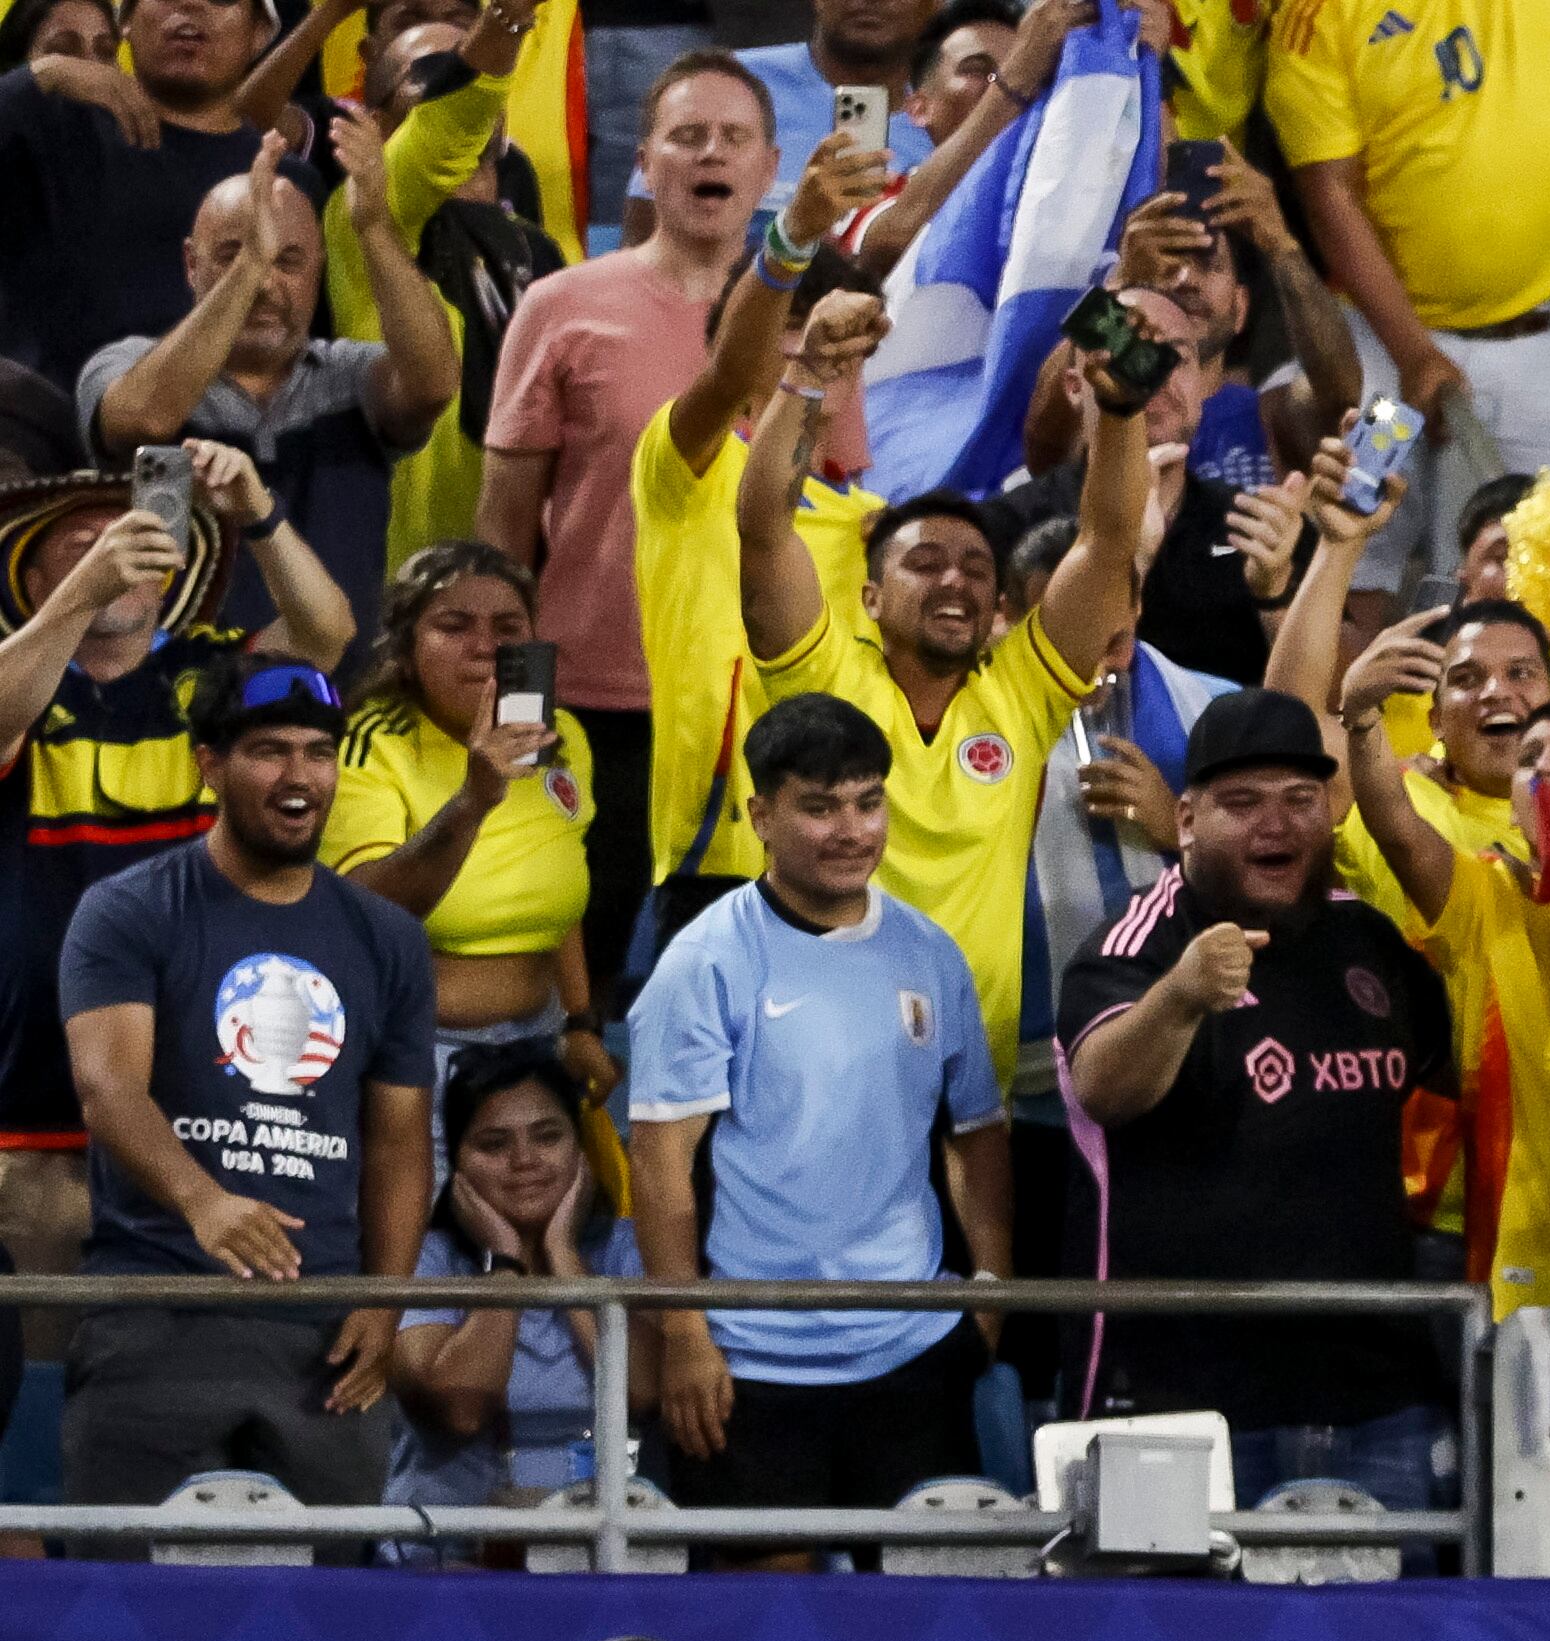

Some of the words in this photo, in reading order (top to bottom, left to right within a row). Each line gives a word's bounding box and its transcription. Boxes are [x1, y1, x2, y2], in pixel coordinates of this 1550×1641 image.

[1309, 1049, 1406, 1091] XBTO
[172, 1117, 249, 1147] COPA
[221, 1148, 266, 1175] USA
